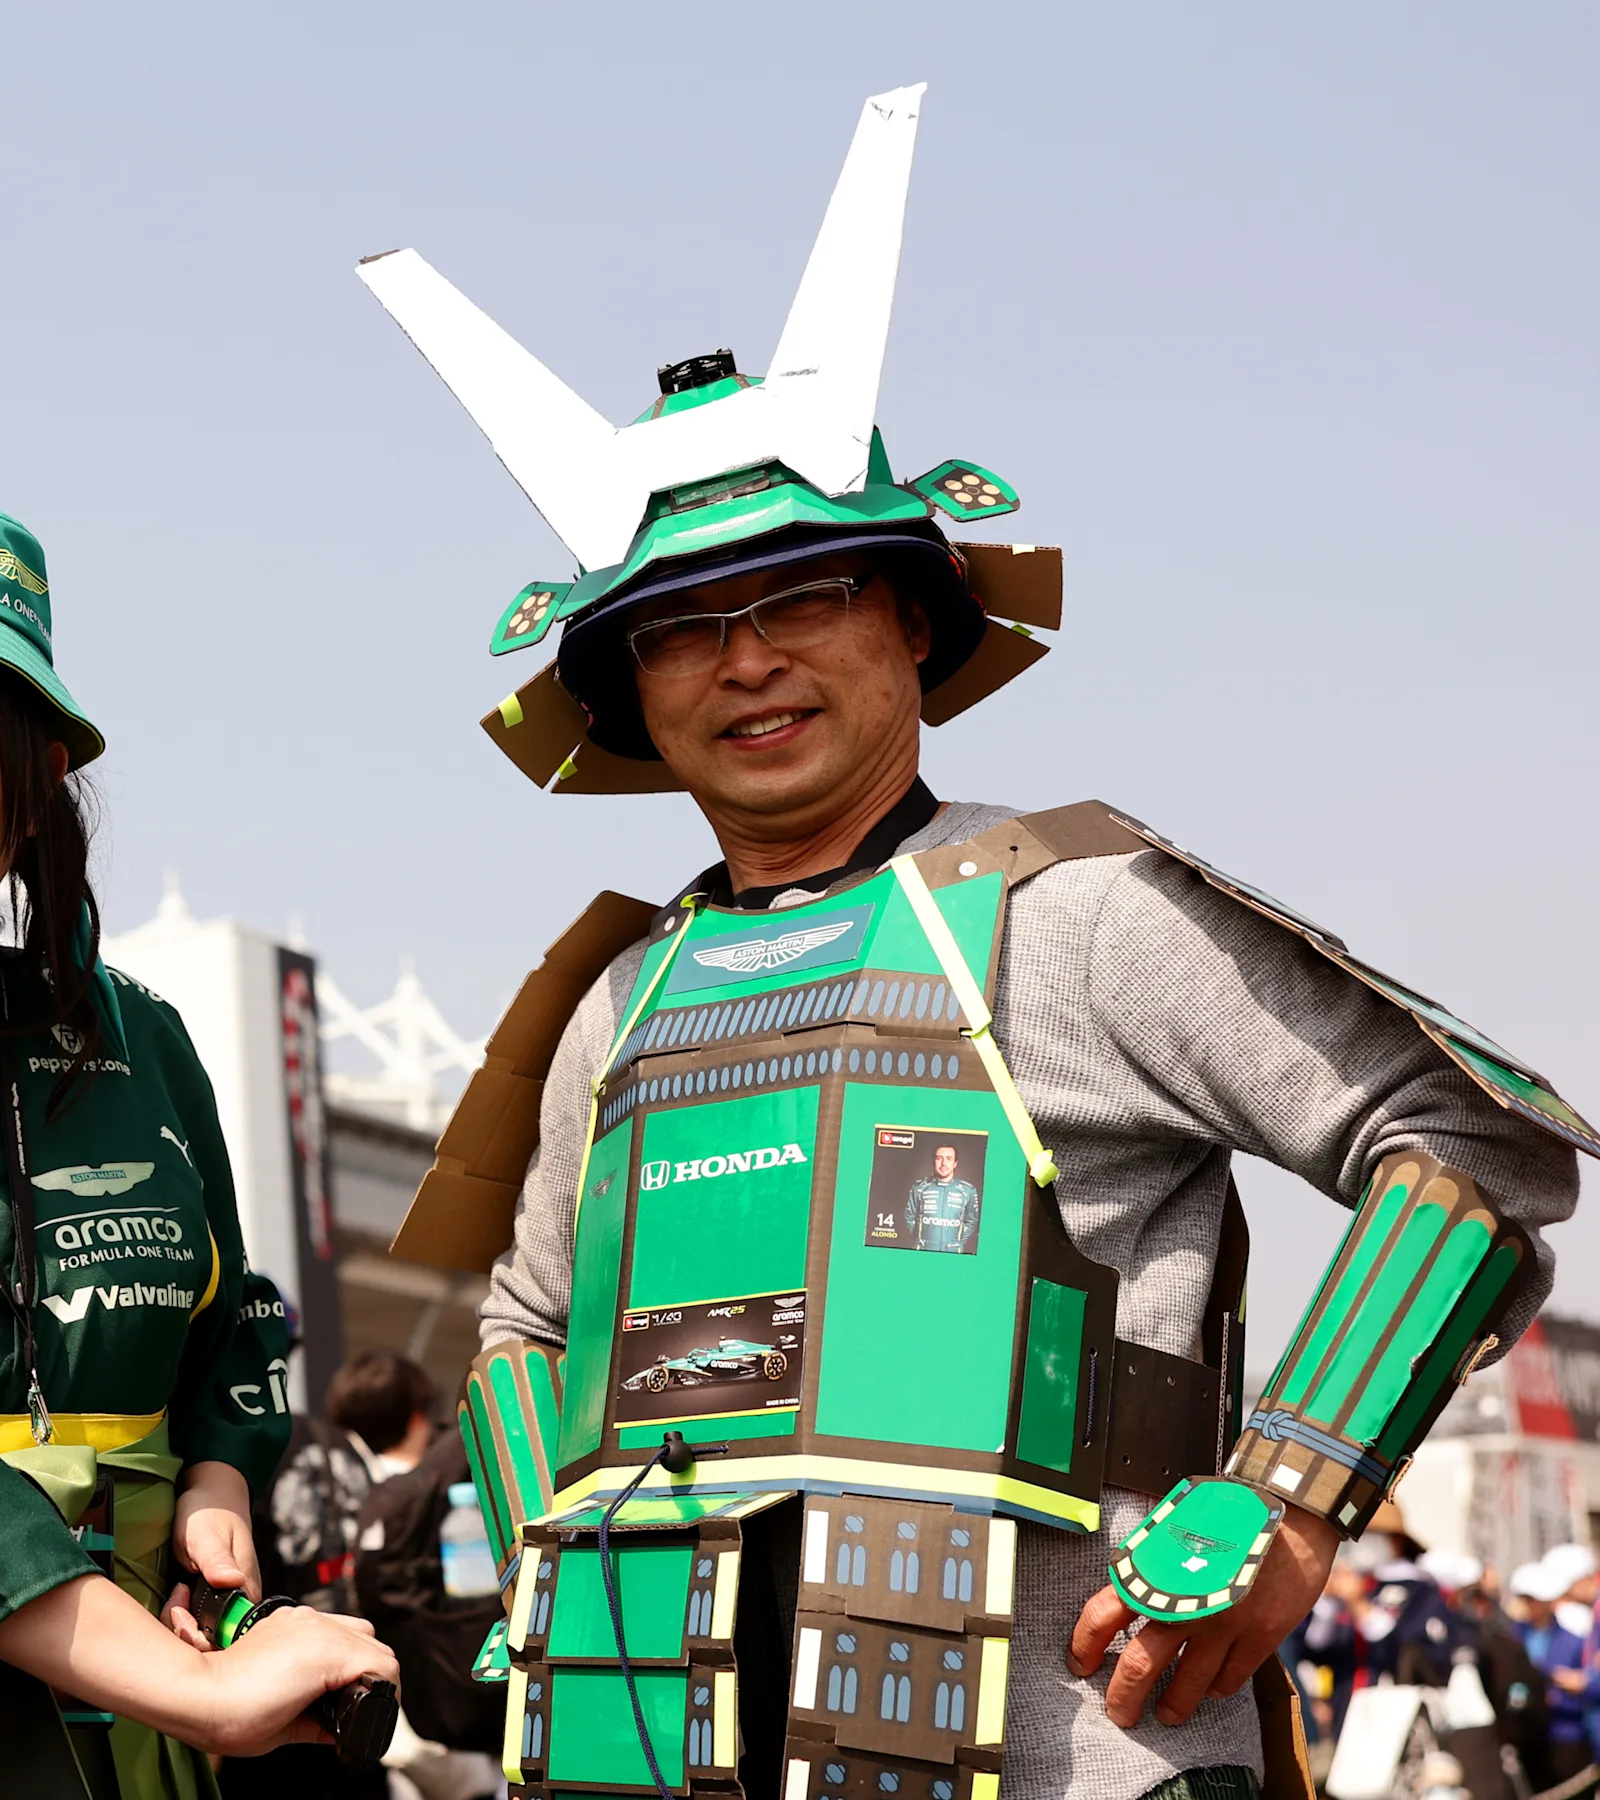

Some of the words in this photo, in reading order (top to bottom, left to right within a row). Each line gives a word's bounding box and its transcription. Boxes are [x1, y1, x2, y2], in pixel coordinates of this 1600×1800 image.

[735, 944, 766, 959] ASTON
[766, 937, 804, 953] MARTIN
[673, 1142, 807, 1184] HONDA
[71, 1173, 98, 1183] ASTON
[98, 1170, 126, 1180] MARTIN
[877, 1213, 894, 1227] 14
[922, 1216, 960, 1227] aramco
[55, 1216, 183, 1250] aramco
[871, 1231, 898, 1239] ALONSO
[59, 1246, 135, 1272] FORMULA
[136, 1245, 162, 1259] ONE
[164, 1248, 195, 1262] TEAM
[95, 1281, 195, 1310] Valvoline
[651, 1311, 682, 1324] 1/43
[772, 1310, 805, 1322] aramco
[710, 1359, 739, 1370] aramco
